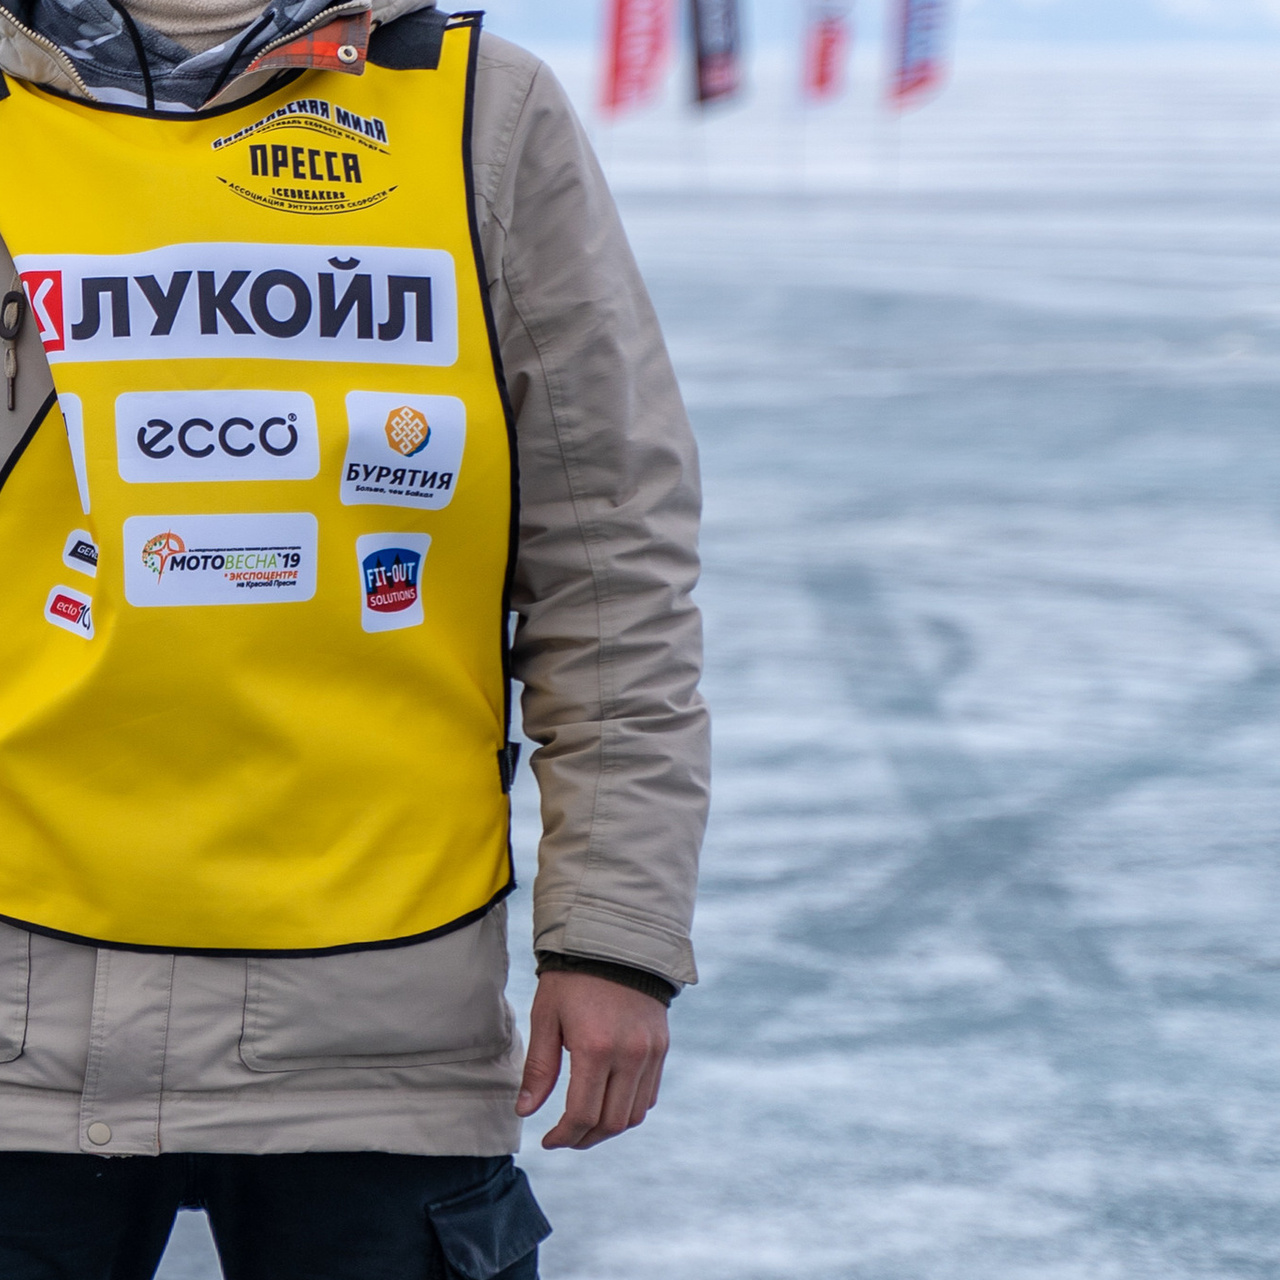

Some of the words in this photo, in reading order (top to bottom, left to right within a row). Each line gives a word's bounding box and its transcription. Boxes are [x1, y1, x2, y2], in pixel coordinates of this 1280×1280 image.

[304, 120, 343, 137] СКОРОСТИ
[335, 106, 388, 144] МИЛЯ
[249, 144, 362, 184] ПРЕССА
[228, 182, 285, 208] АССОЦИАЦИЯ
[287, 202, 346, 211] ЭНТУЗИАСТОВ
[347, 190, 388, 208] СКОРОСТИ
[271, 187, 346, 200] ICEBREAKERS
[71, 256, 434, 342] ЛУКОЙЛ
[346, 463, 454, 490] БУРЯТИЯ
[229, 570, 299, 582] ЭКСПОЦЕНТРЕ
[366, 562, 416, 588] FIT-OUT
[369, 588, 416, 607] SOLUTIONS
